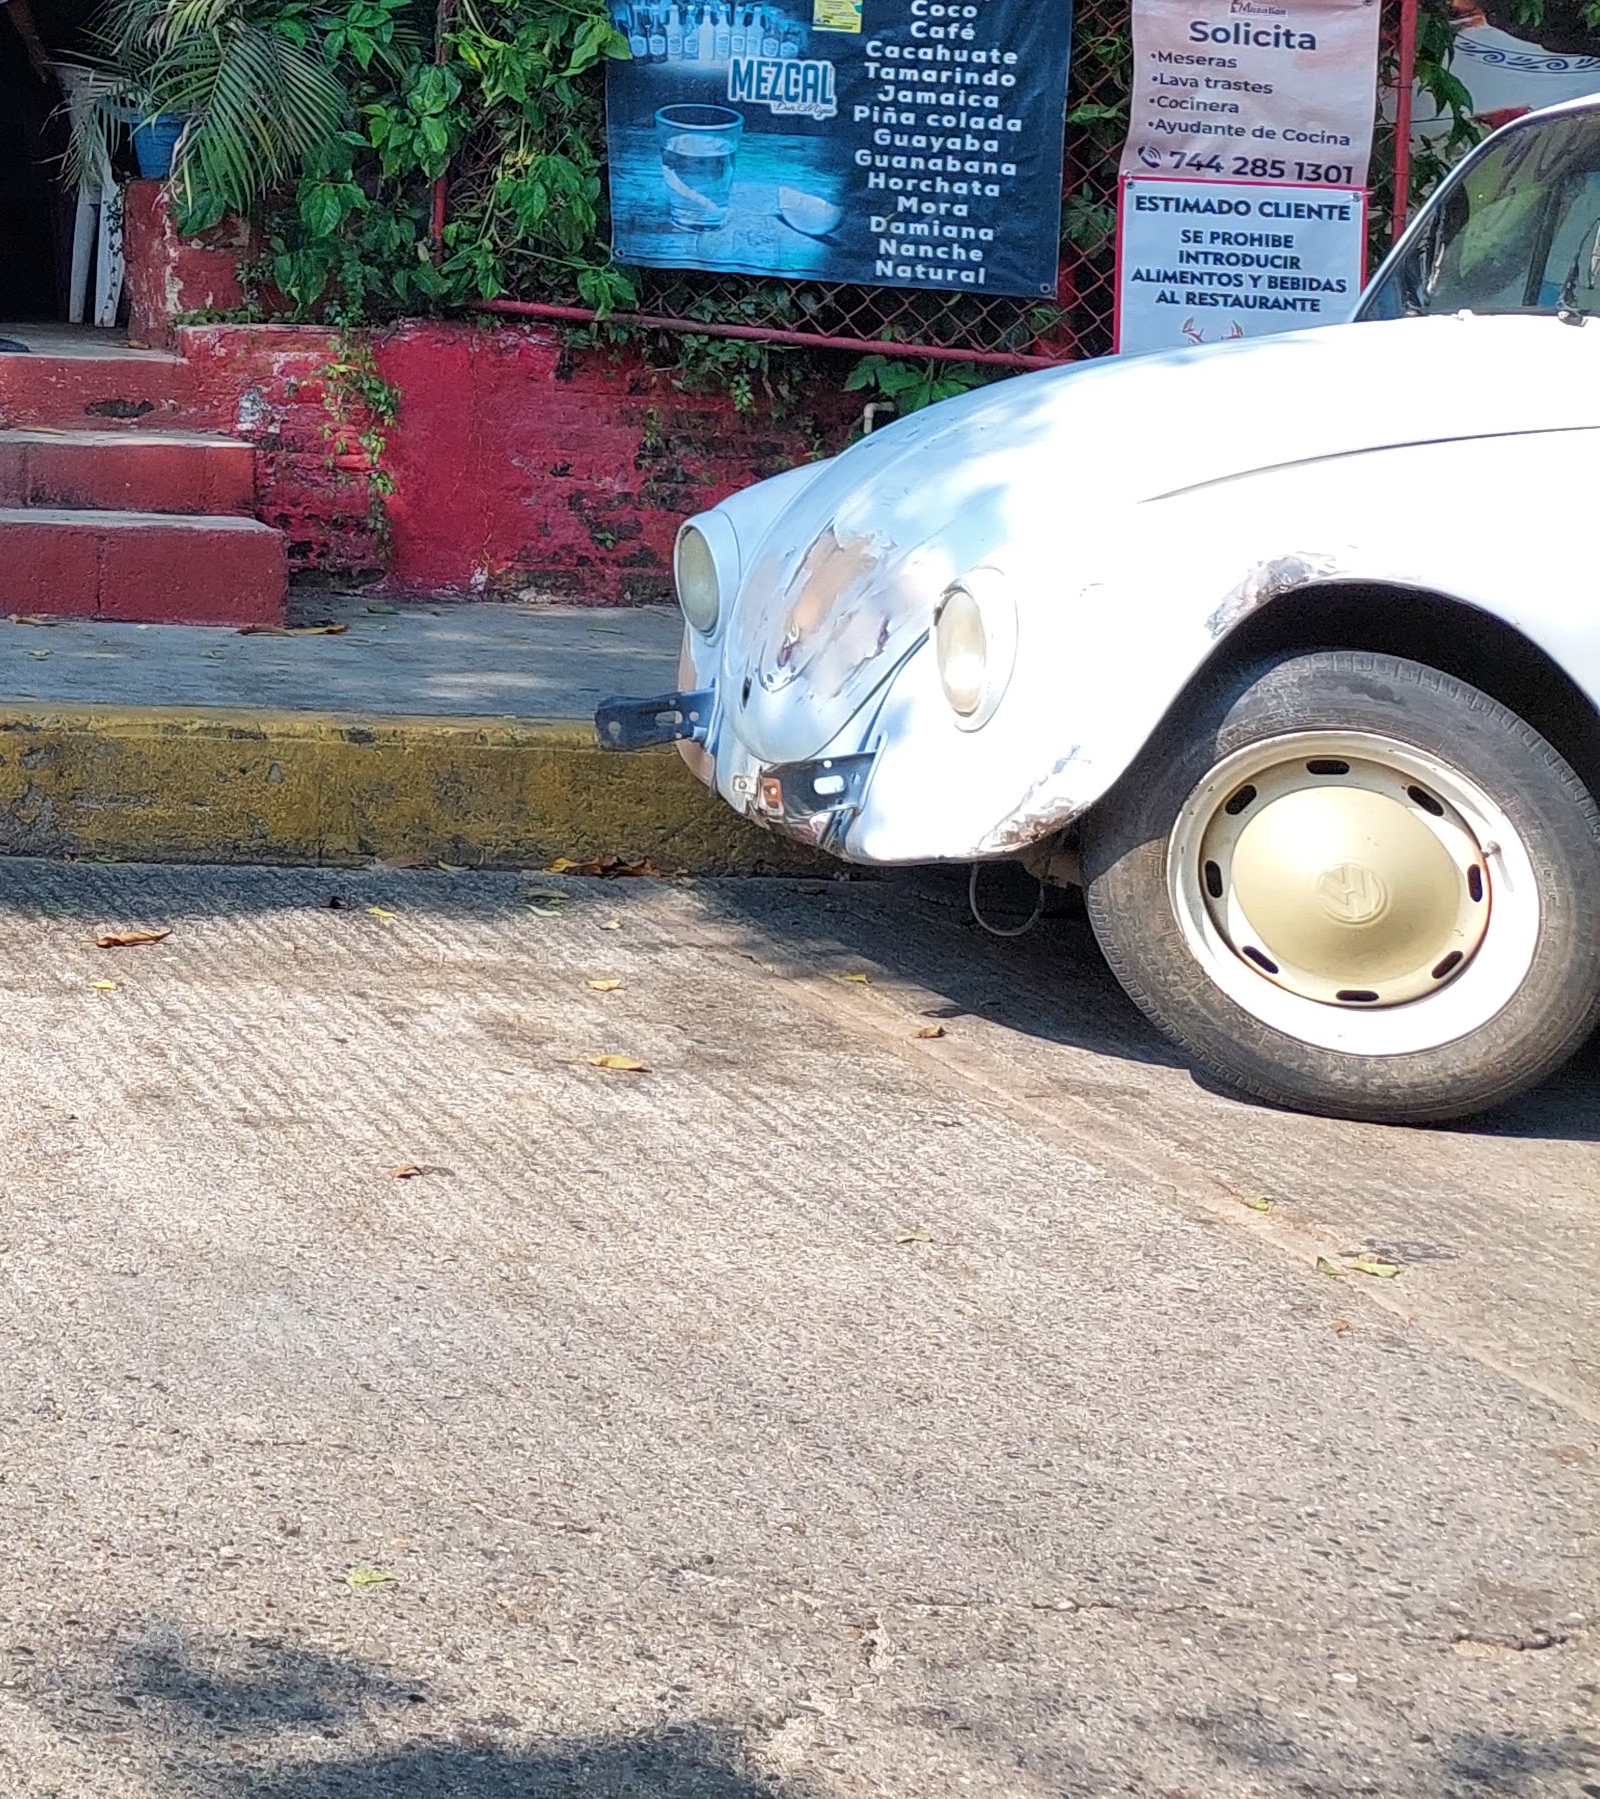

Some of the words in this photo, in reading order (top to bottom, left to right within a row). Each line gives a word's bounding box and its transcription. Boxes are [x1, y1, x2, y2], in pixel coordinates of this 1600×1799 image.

[910, 0, 978, 20] Coco
[910, 20, 976, 41] Café
[1189, 20, 1317, 50] Solicita
[865, 41, 1018, 65] Cacahuate
[1157, 50, 1238, 69] Meseras
[731, 58, 833, 105] MEZCAL
[864, 62, 1016, 87] Tamarindo
[1159, 72, 1199, 89] Lava
[1204, 76, 1274, 95] trastes
[877, 85, 999, 108] Jamaica
[1156, 95, 1240, 114] Cocinera
[853, 105, 916, 126] Piña
[926, 112, 1022, 132] colada
[873, 128, 999, 153] Guayaba
[1153, 118, 1247, 138] Ayudante
[1251, 125, 1277, 140] de
[1282, 128, 1351, 146] Cocina
[854, 149, 1017, 176] Guanabana
[1168, 150, 1225, 174] 744
[1231, 156, 1285, 179] 285
[1294, 161, 1354, 185] 1301
[868, 172, 1001, 197] Horchata
[897, 196, 969, 217] Mora
[1135, 194, 1251, 218] ESTIMADO
[1258, 199, 1351, 221] CLIENTE
[869, 216, 994, 241] Damiana
[1180, 229, 1204, 244] SE
[1209, 230, 1294, 249] PROHIBE
[879, 238, 984, 262] Nanche
[1178, 250, 1302, 270] INTRODUCIR
[875, 259, 986, 285] Natural
[1131, 268, 1244, 289] ALIMENTOS
[1248, 273, 1263, 289] Y
[1267, 275, 1347, 293] BEBIDAS
[1155, 289, 1180, 305] AL
[1185, 291, 1321, 313] RESTAURANTE
